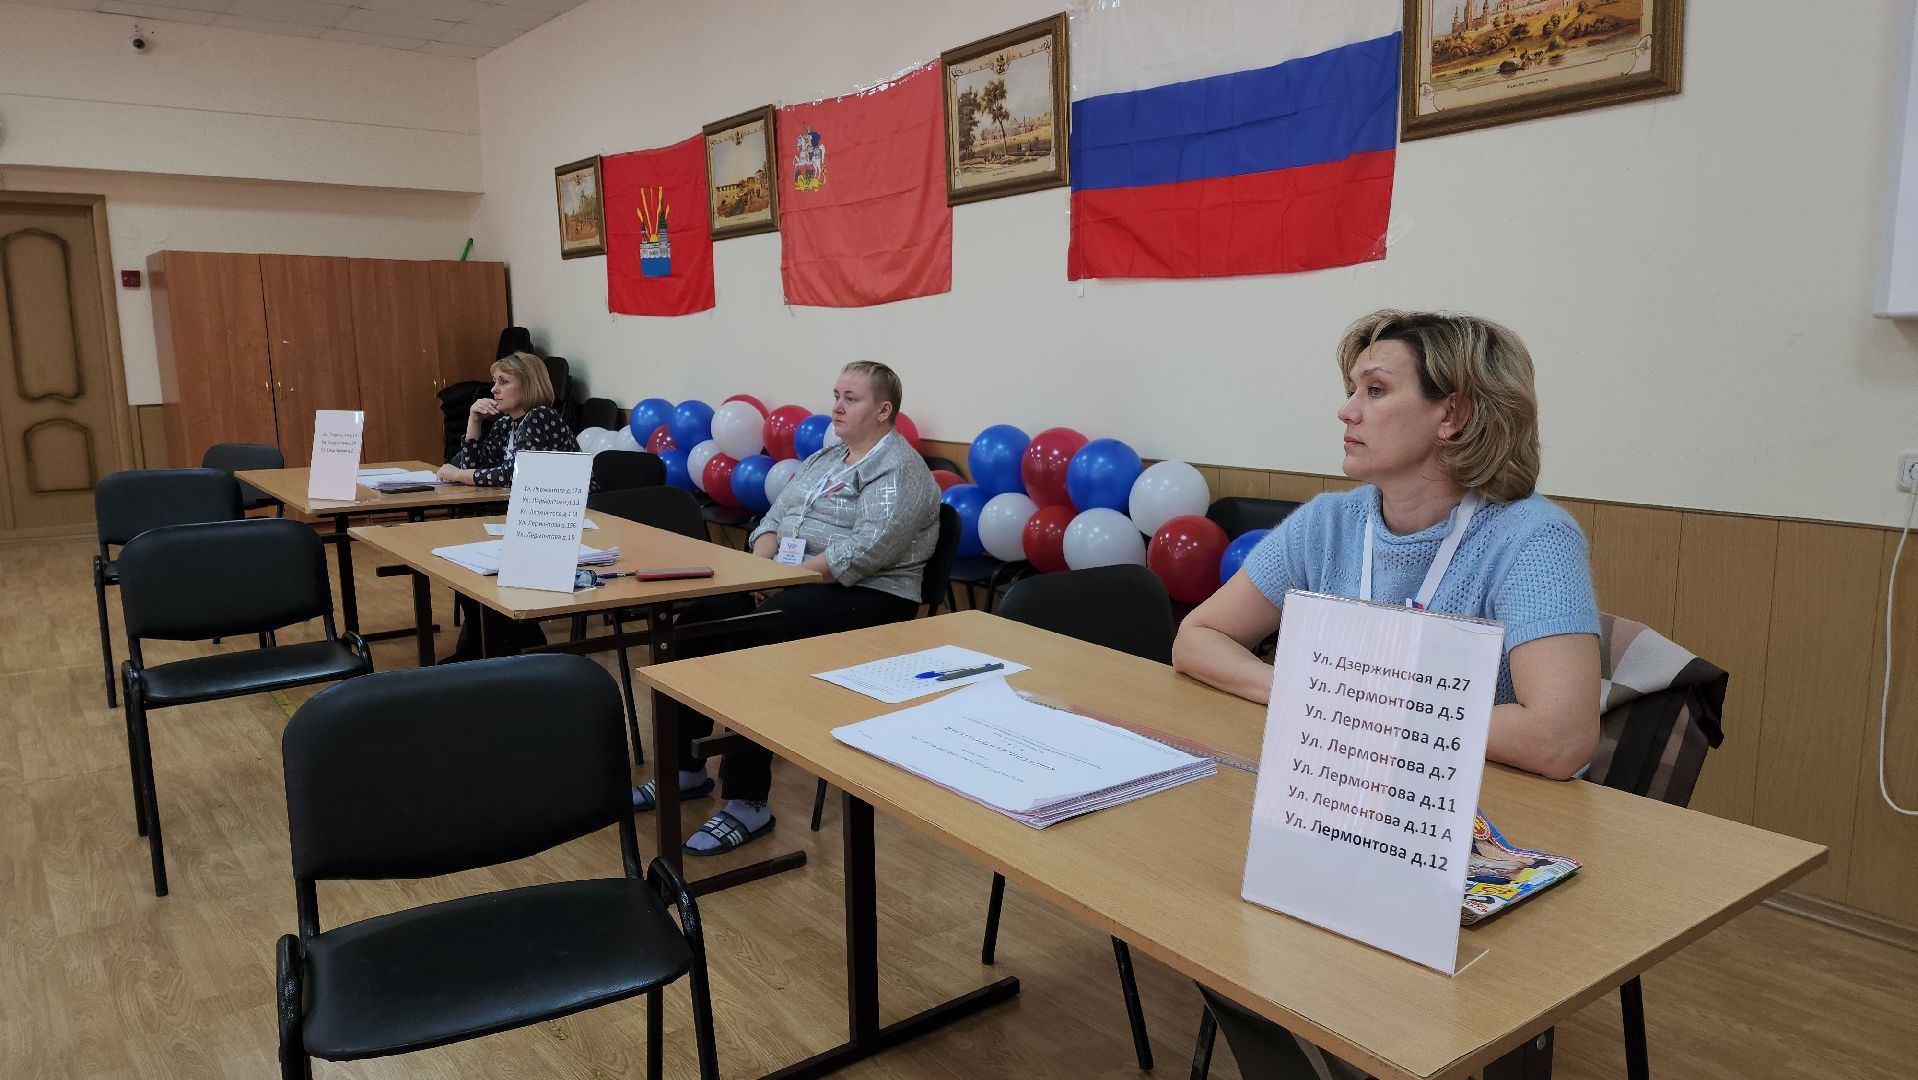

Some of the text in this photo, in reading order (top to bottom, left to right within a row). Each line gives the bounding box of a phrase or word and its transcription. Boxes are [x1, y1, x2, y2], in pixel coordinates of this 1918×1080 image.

[1312, 651, 1471, 692] Ул. Дзержинская д.27
[1308, 676, 1465, 721] Ул. Лермонтова д.5
[1304, 703, 1461, 751] Ул. Лермонтова д.6
[1300, 731, 1457, 781] Ул. Лермонтова д.7
[1292, 758, 1456, 813] Ул. Лермонтова д.11
[1288, 785, 1452, 842] Ул. Лермонтова д.11 А
[1285, 811, 1448, 872] Ул. Лермонтова д.12
